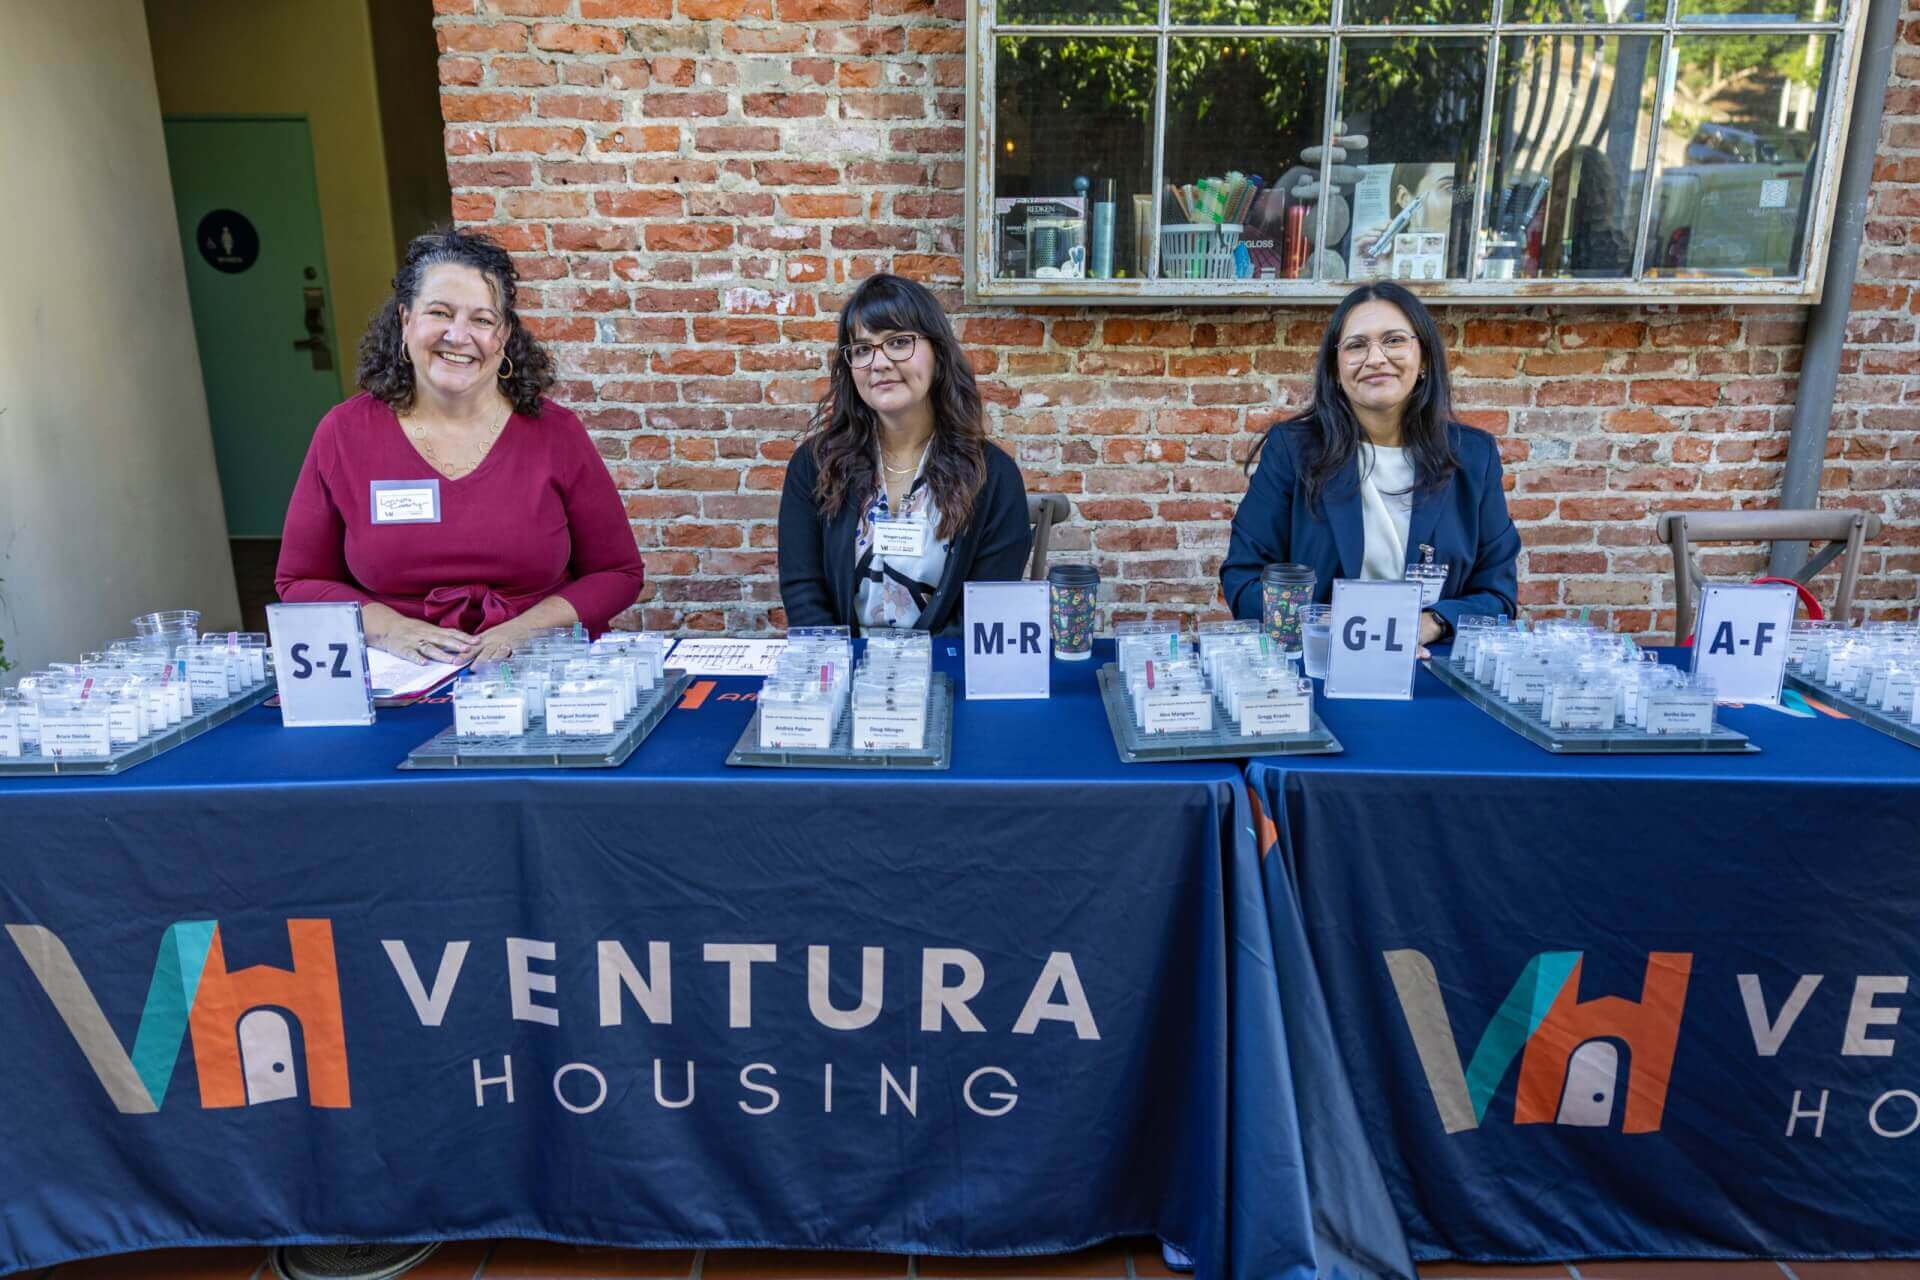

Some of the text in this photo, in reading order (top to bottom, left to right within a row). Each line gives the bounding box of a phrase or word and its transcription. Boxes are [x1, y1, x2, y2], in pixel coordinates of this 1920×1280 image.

[1026, 205, 1056, 213] REDKEN
[973, 622, 1042, 656] M-R
[1342, 615, 1404, 653] G-L
[1708, 621, 1777, 657] A-F
[290, 642, 352, 680] S-Z
[380, 936, 1102, 1041] VENTURA
[472, 1054, 1020, 1119] HOUSING
